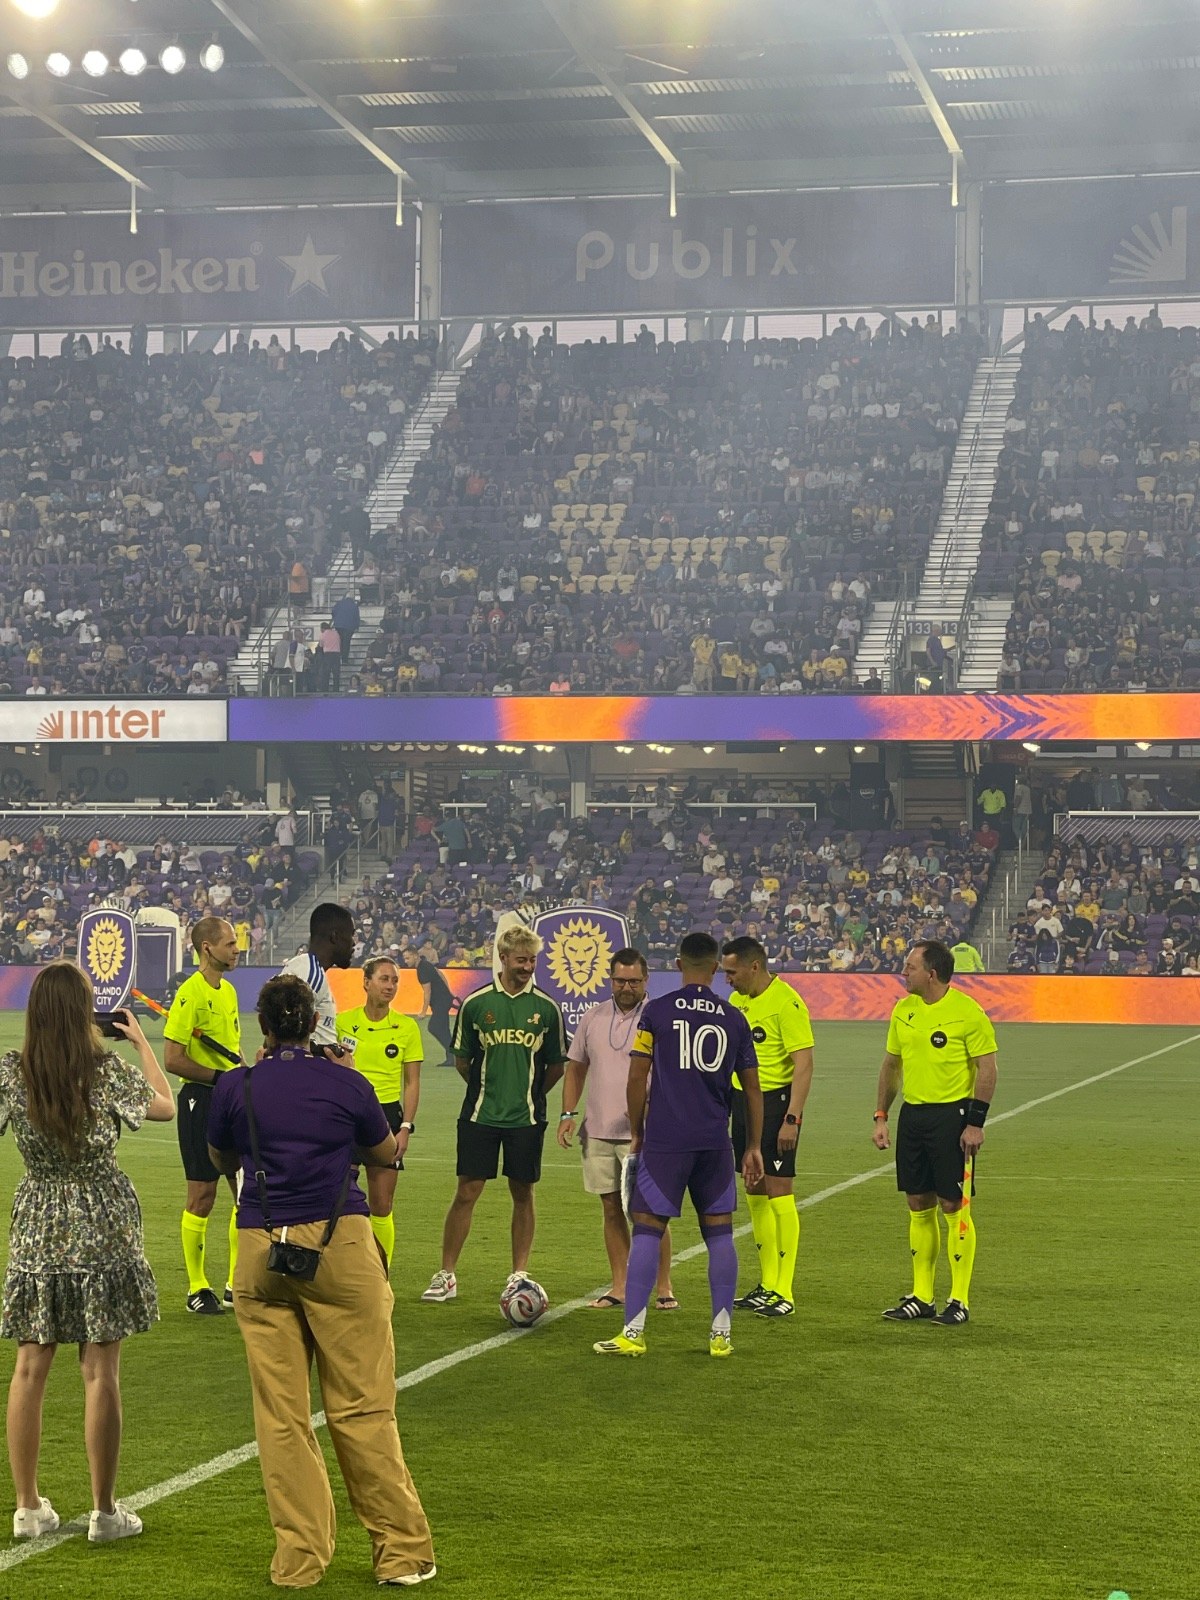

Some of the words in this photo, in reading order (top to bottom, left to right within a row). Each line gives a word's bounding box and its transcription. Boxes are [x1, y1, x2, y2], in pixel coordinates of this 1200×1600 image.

[575, 224, 799, 282] Publix
[291, 628, 313, 640] 12
[907, 622, 931, 634] 133
[943, 622, 968, 635] 13
[71, 704, 165, 739] inter
[93, 986, 122, 996] RLANDO
[96, 996, 112, 1006] CITY
[561, 1001, 600, 1013] RLAN
[675, 998, 725, 1016] OJEDA
[343, 1036, 357, 1047] FIFA
[673, 1020, 728, 1073] 10
